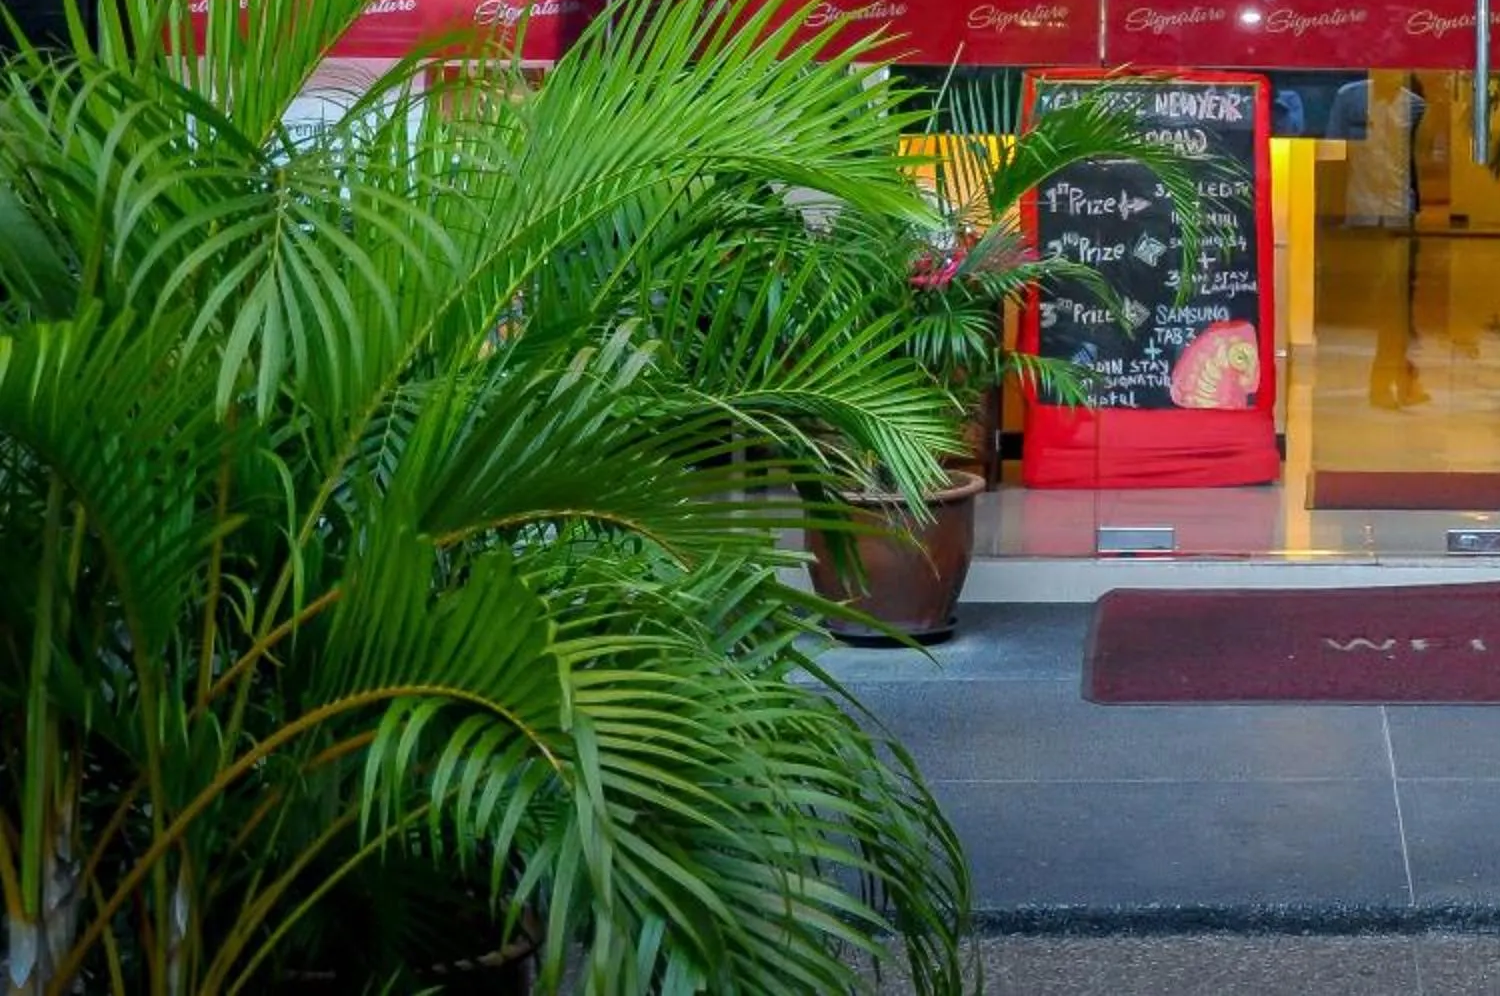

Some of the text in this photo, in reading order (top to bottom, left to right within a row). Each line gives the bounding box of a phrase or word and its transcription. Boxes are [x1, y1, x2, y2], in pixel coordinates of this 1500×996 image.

[967, 4, 1069, 33] Signature
[1125, 5, 1226, 35] Signature
[1265, 6, 1368, 37] Signature
[1069, 186, 1117, 217] Prize
[1079, 236, 1126, 263] Prize
[1155, 304, 1230, 326] SAMSUNG
[1129, 358, 1170, 375] STAY
